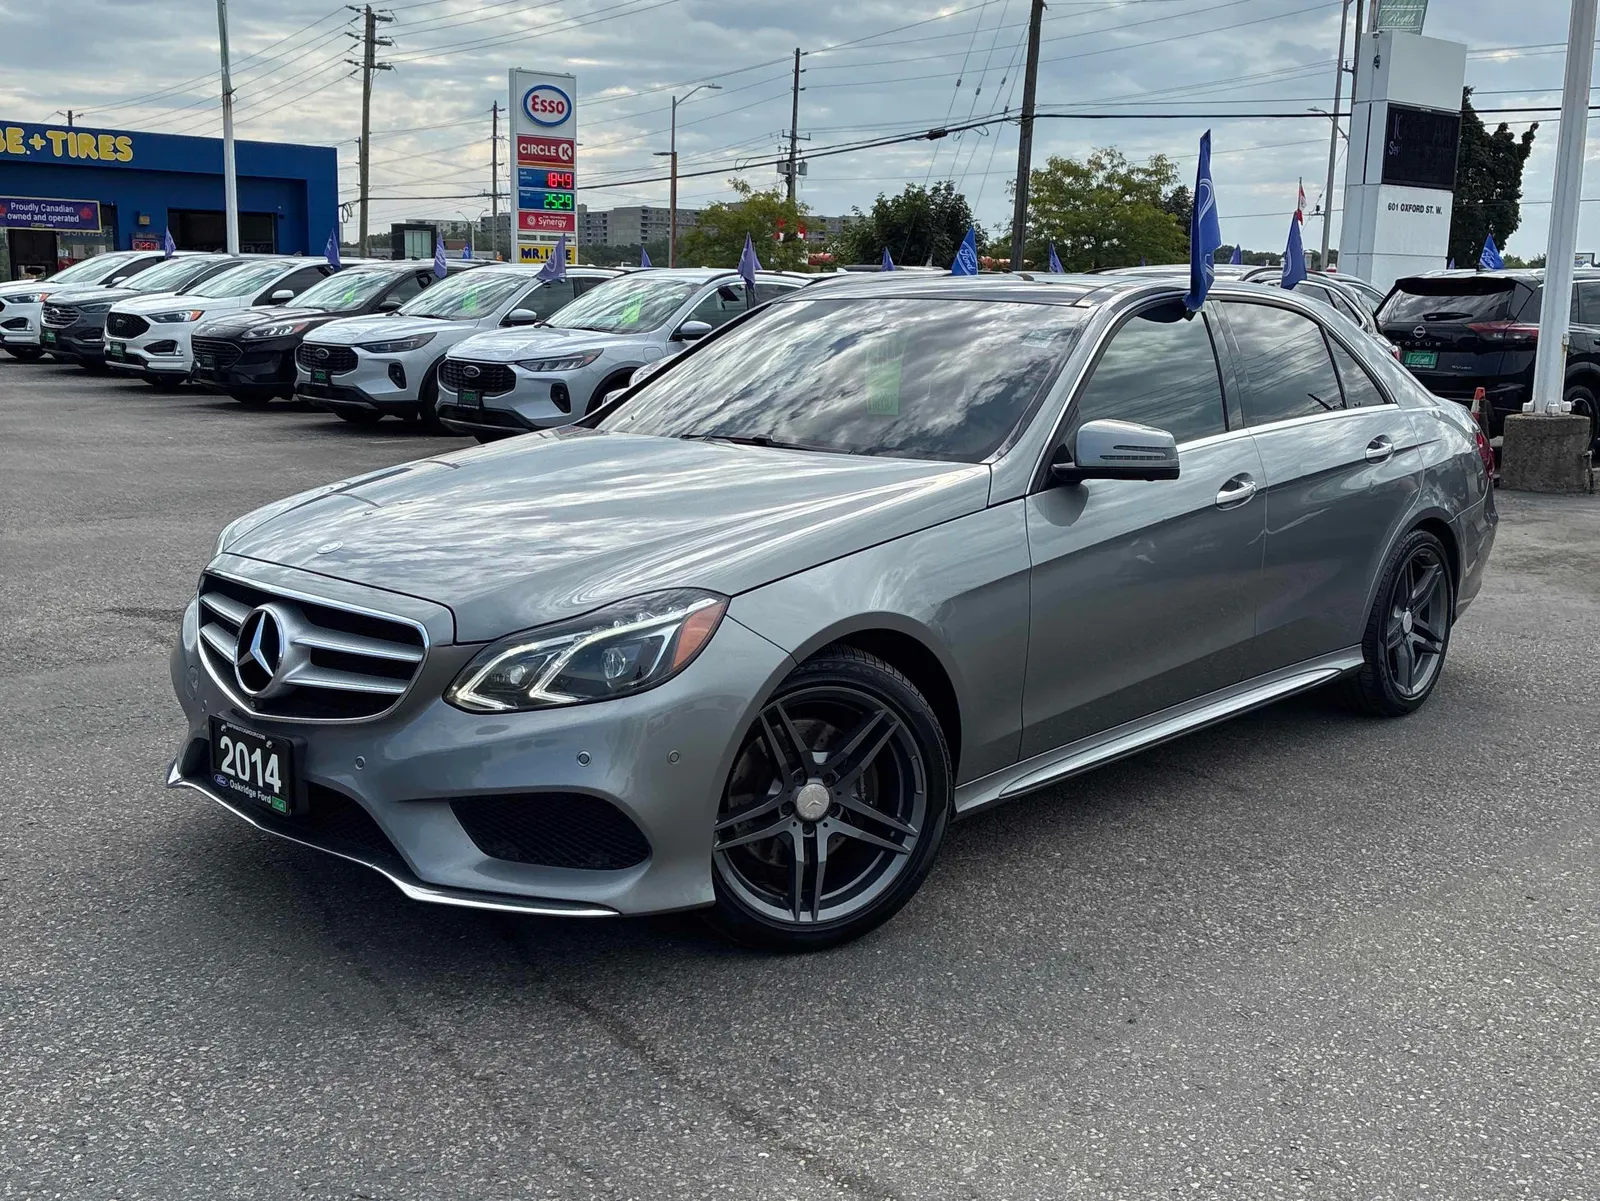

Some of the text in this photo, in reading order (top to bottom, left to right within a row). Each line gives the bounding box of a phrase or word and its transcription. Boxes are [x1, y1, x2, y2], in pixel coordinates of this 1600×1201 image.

[531, 94, 565, 115] Esso
[46, 130, 134, 162] TIRES
[519, 143, 572, 159] CIRCLE K
[10, 202, 75, 213] Proudly Canadian
[1387, 202, 1399, 211] 601
[1400, 203, 1425, 213] OXFORD
[7, 212, 80, 223] owned and operated
[538, 216, 567, 228] Synergy
[134, 241, 158, 251] OPEN
[521, 247, 544, 260] MR.
[220, 735, 282, 794] 2014
[229, 779, 257, 799] Oakridge
[257, 790, 272, 805] Ford
